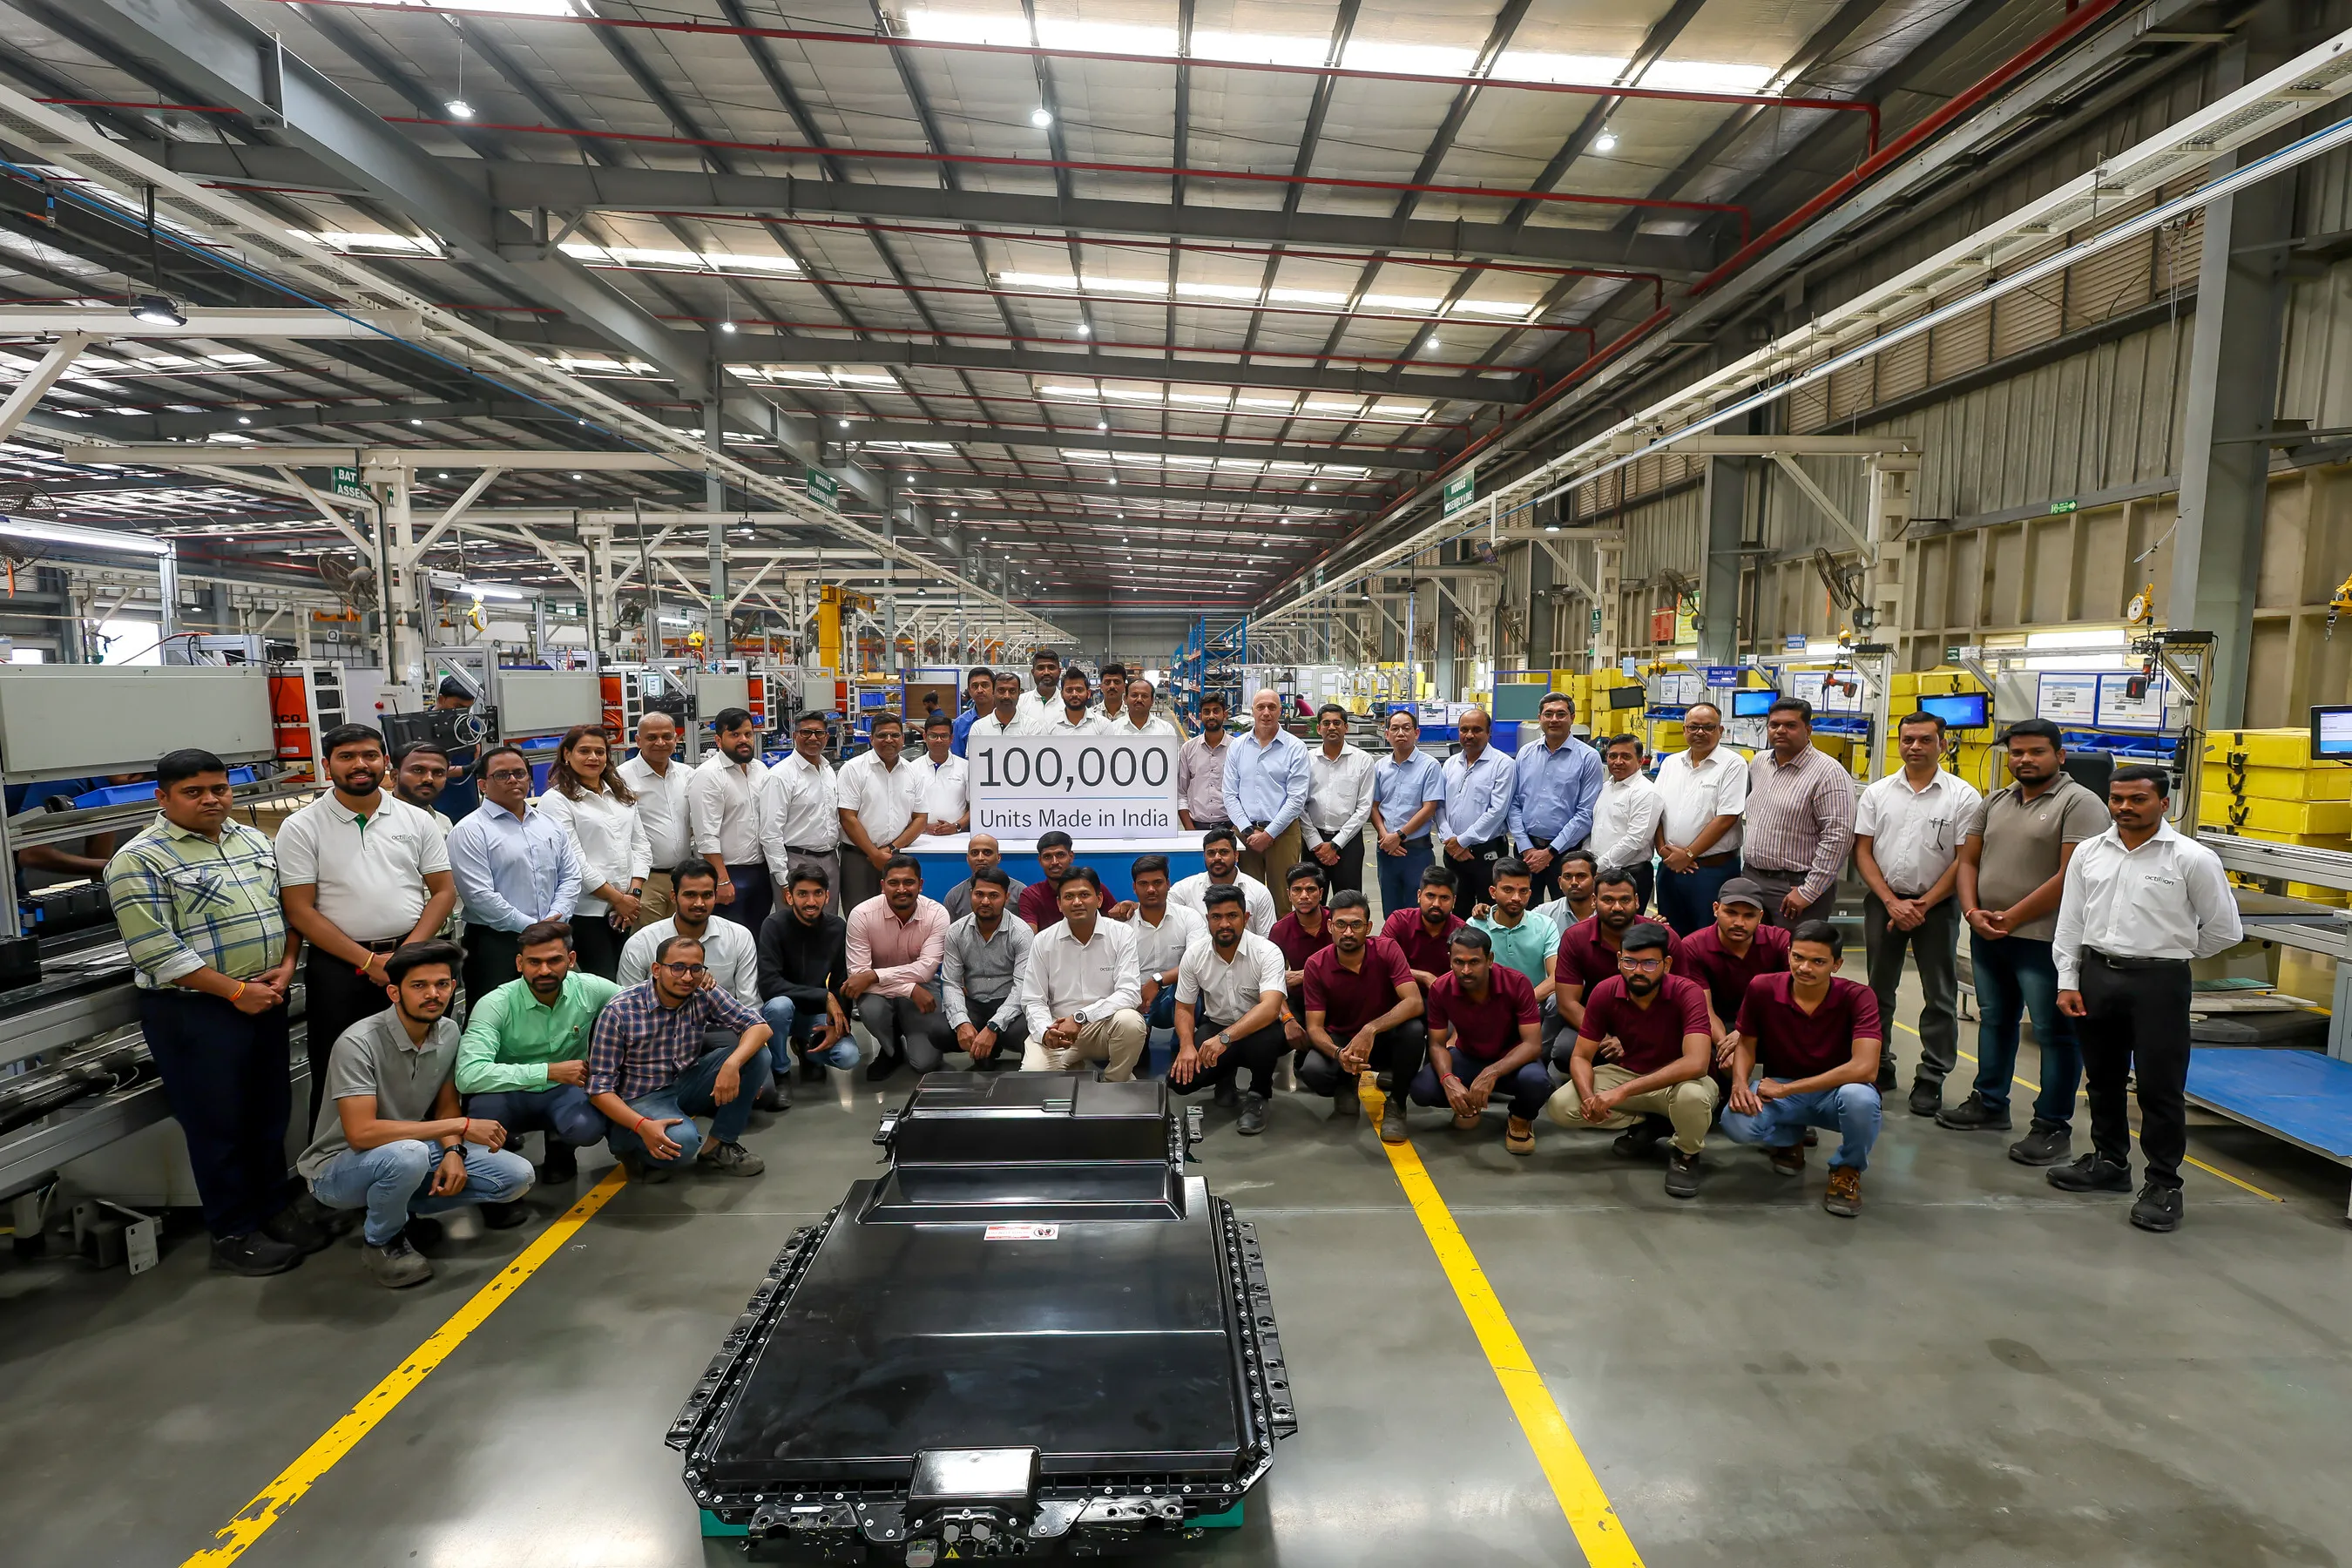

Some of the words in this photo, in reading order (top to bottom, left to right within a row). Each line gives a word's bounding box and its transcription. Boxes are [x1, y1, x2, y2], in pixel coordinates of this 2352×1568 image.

[814, 474, 831, 491] MODULE
[1450, 478, 1466, 495] MODULE
[1463, 490, 1472, 504] LINE
[978, 747, 1169, 792] 100,000
[980, 809, 1032, 828] Units
[1038, 808, 1092, 828] Made
[1098, 809, 1116, 828] in
[1122, 808, 1169, 828] India
[2145, 875, 2174, 885] octillion
